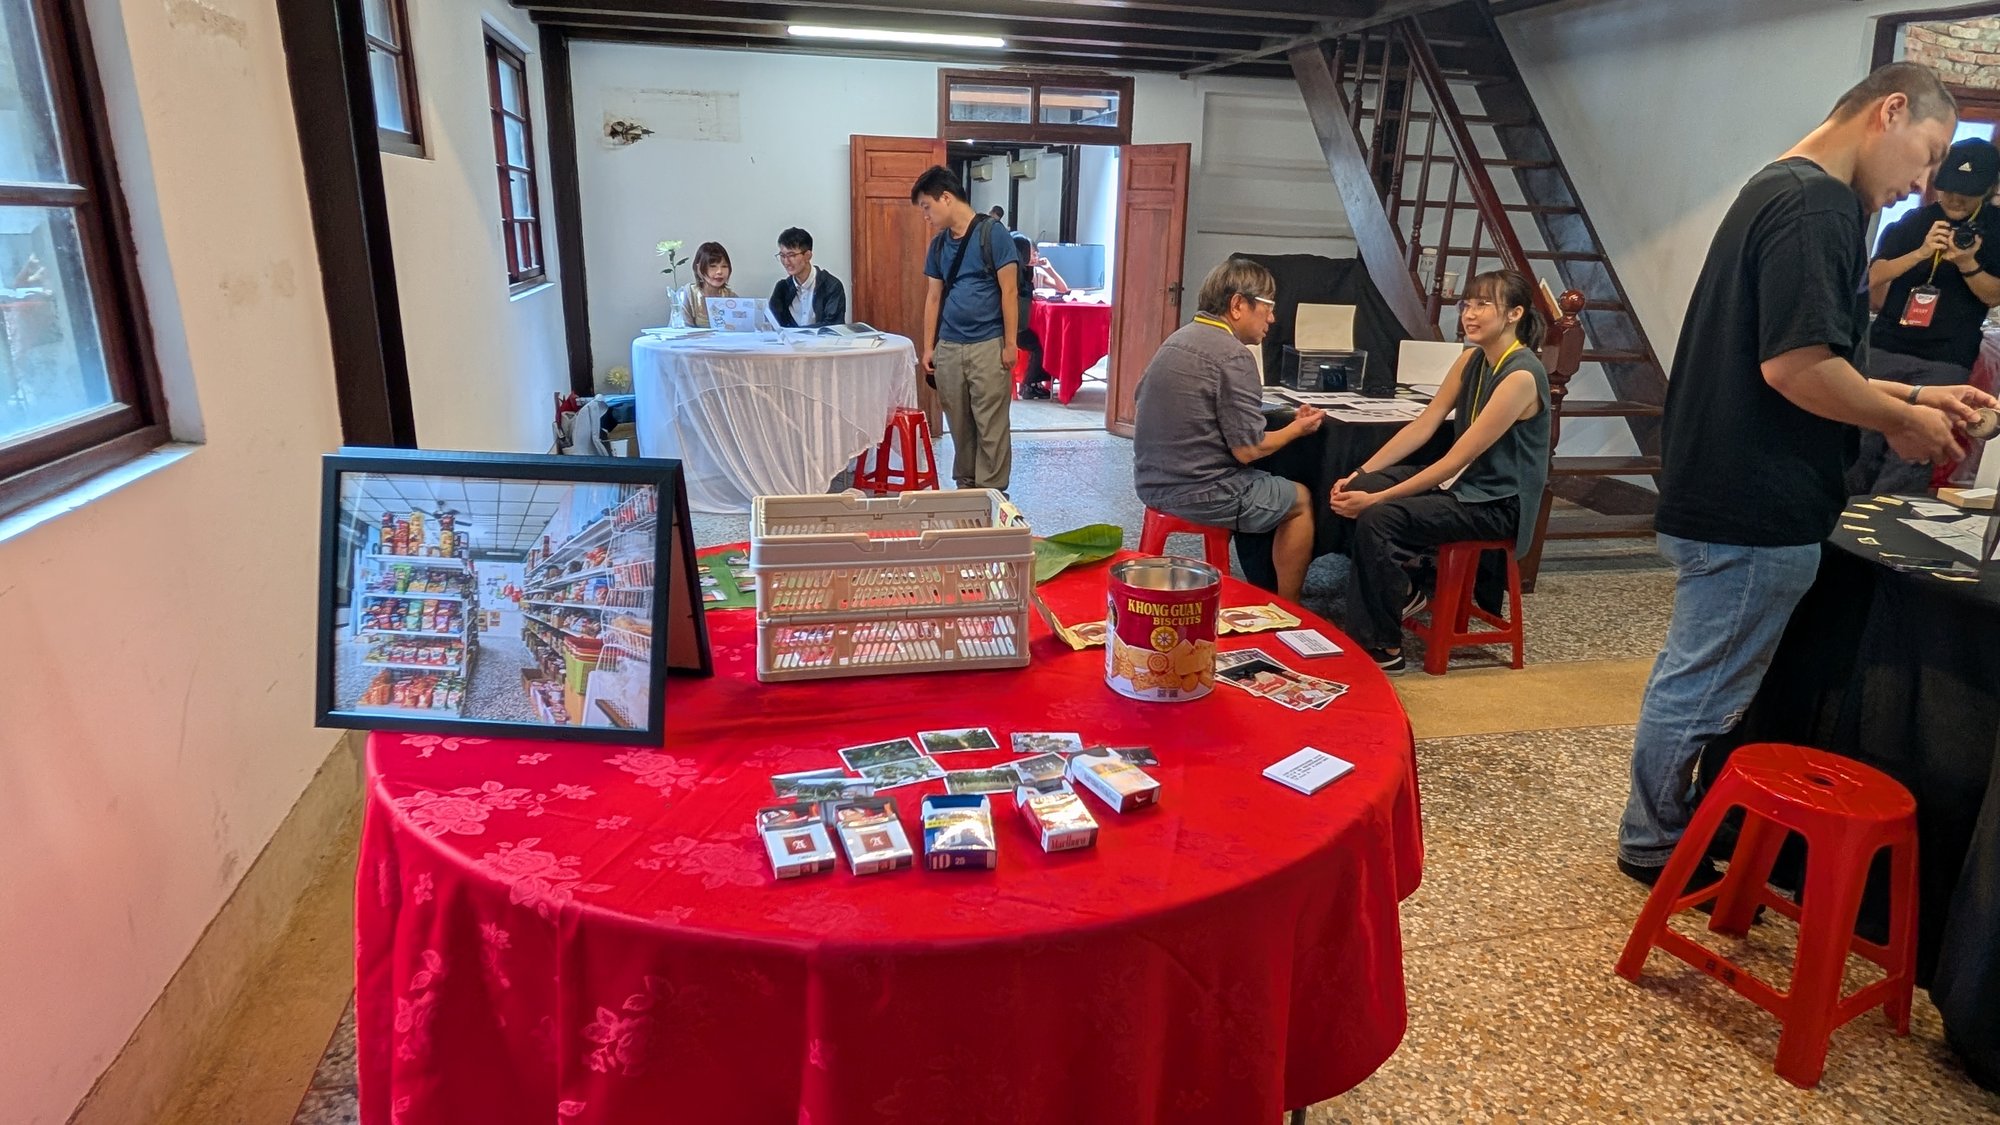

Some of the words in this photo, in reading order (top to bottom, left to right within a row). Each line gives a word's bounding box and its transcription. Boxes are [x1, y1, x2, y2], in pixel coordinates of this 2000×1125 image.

[1127, 598, 1169, 617] KHONG
[1170, 602, 1203, 617] GUAN
[1152, 615, 1202, 626] BISCUITS
